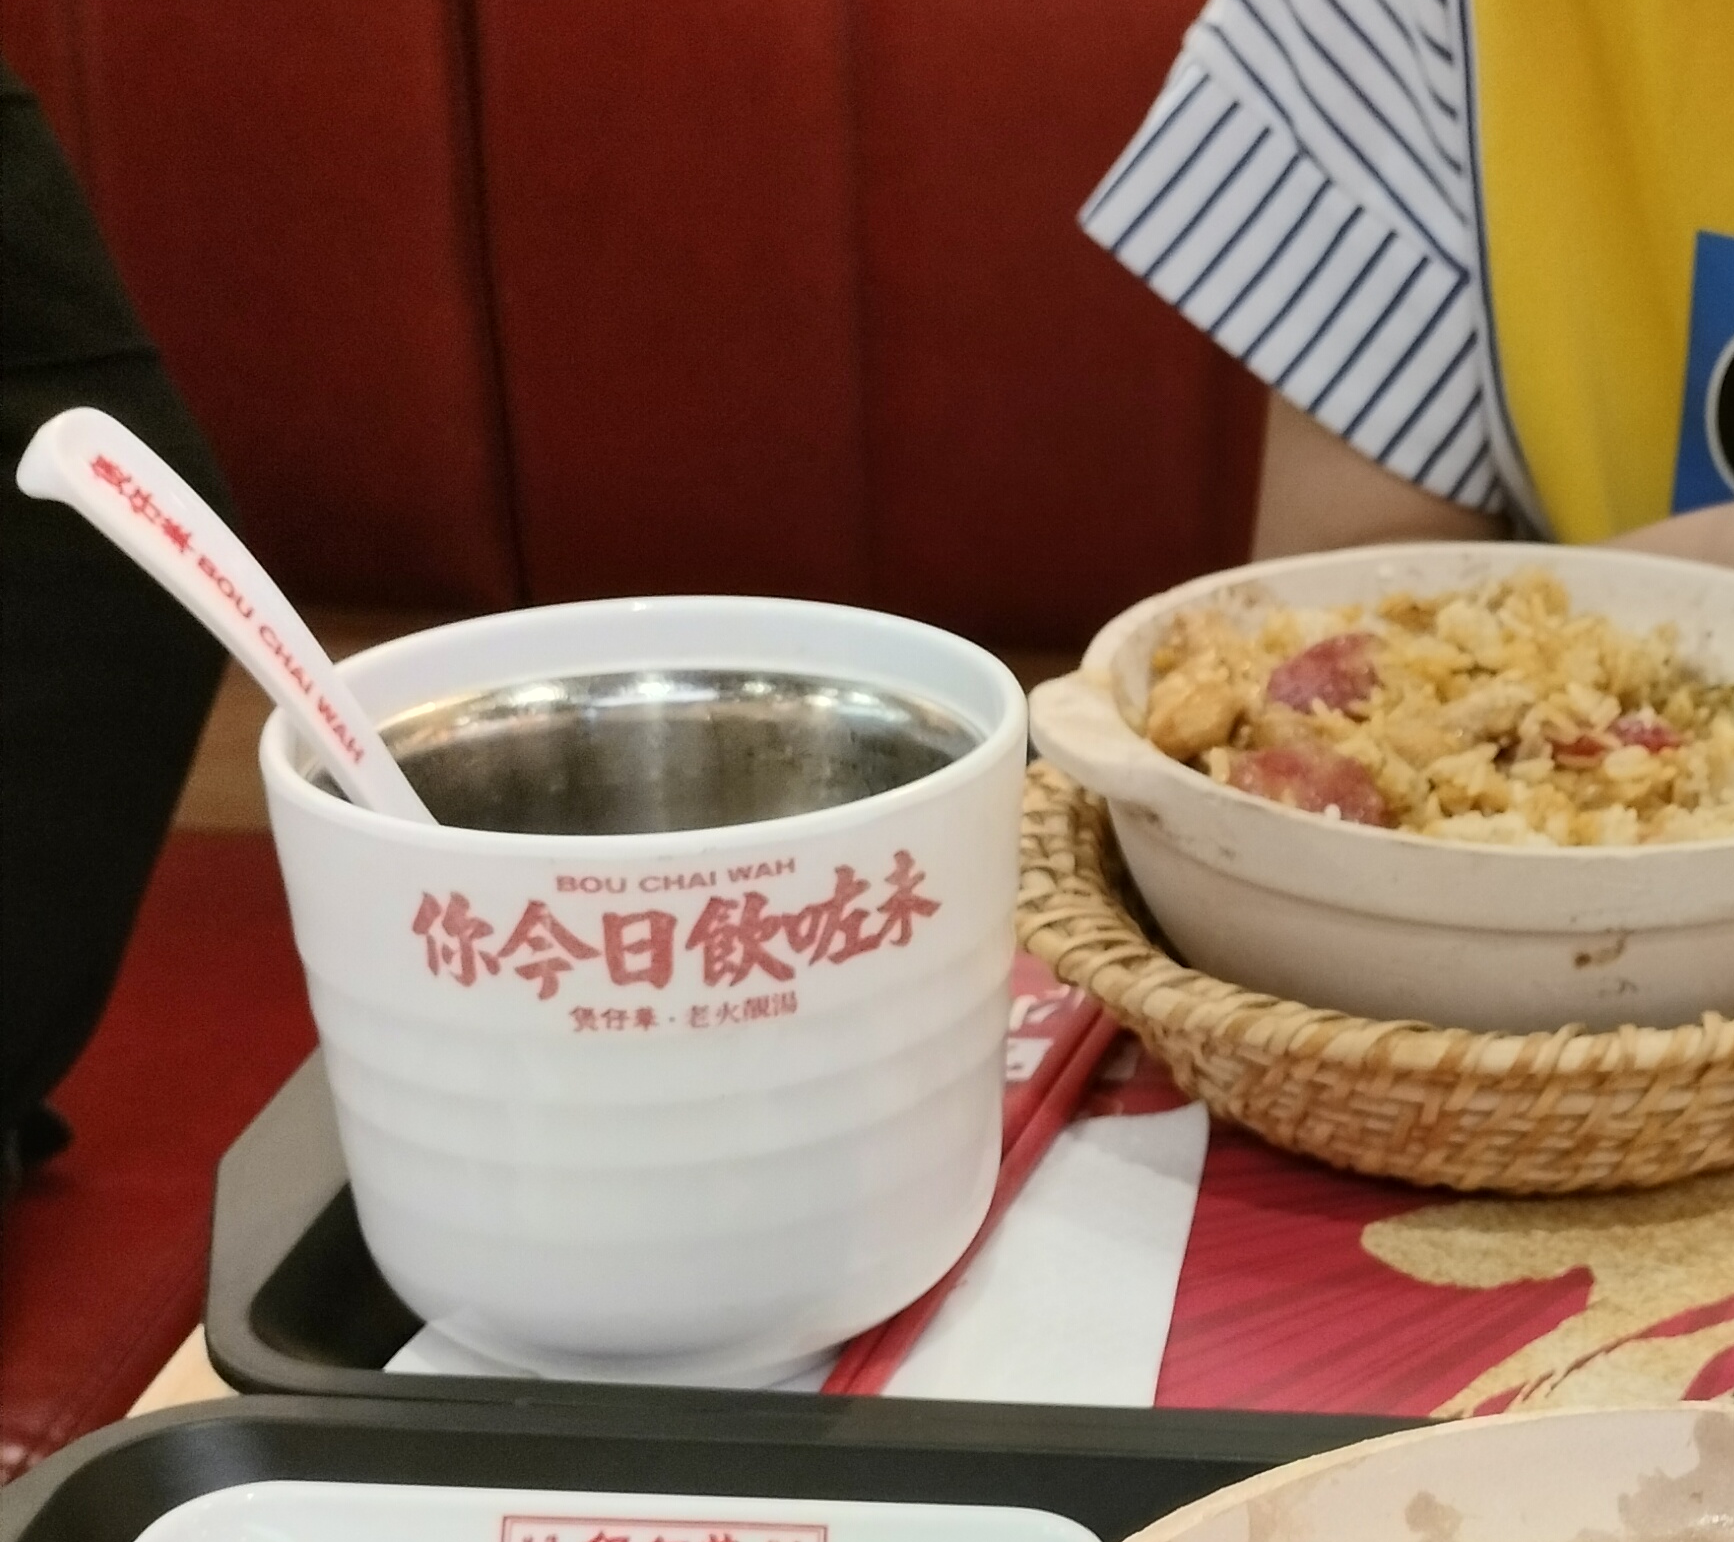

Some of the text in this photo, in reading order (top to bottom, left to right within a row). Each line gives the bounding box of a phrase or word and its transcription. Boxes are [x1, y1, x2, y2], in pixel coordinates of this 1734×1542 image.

[198, 556, 364, 764] BOU CHAI WAH
[556, 858, 796, 894] BOU CHAI WAH
